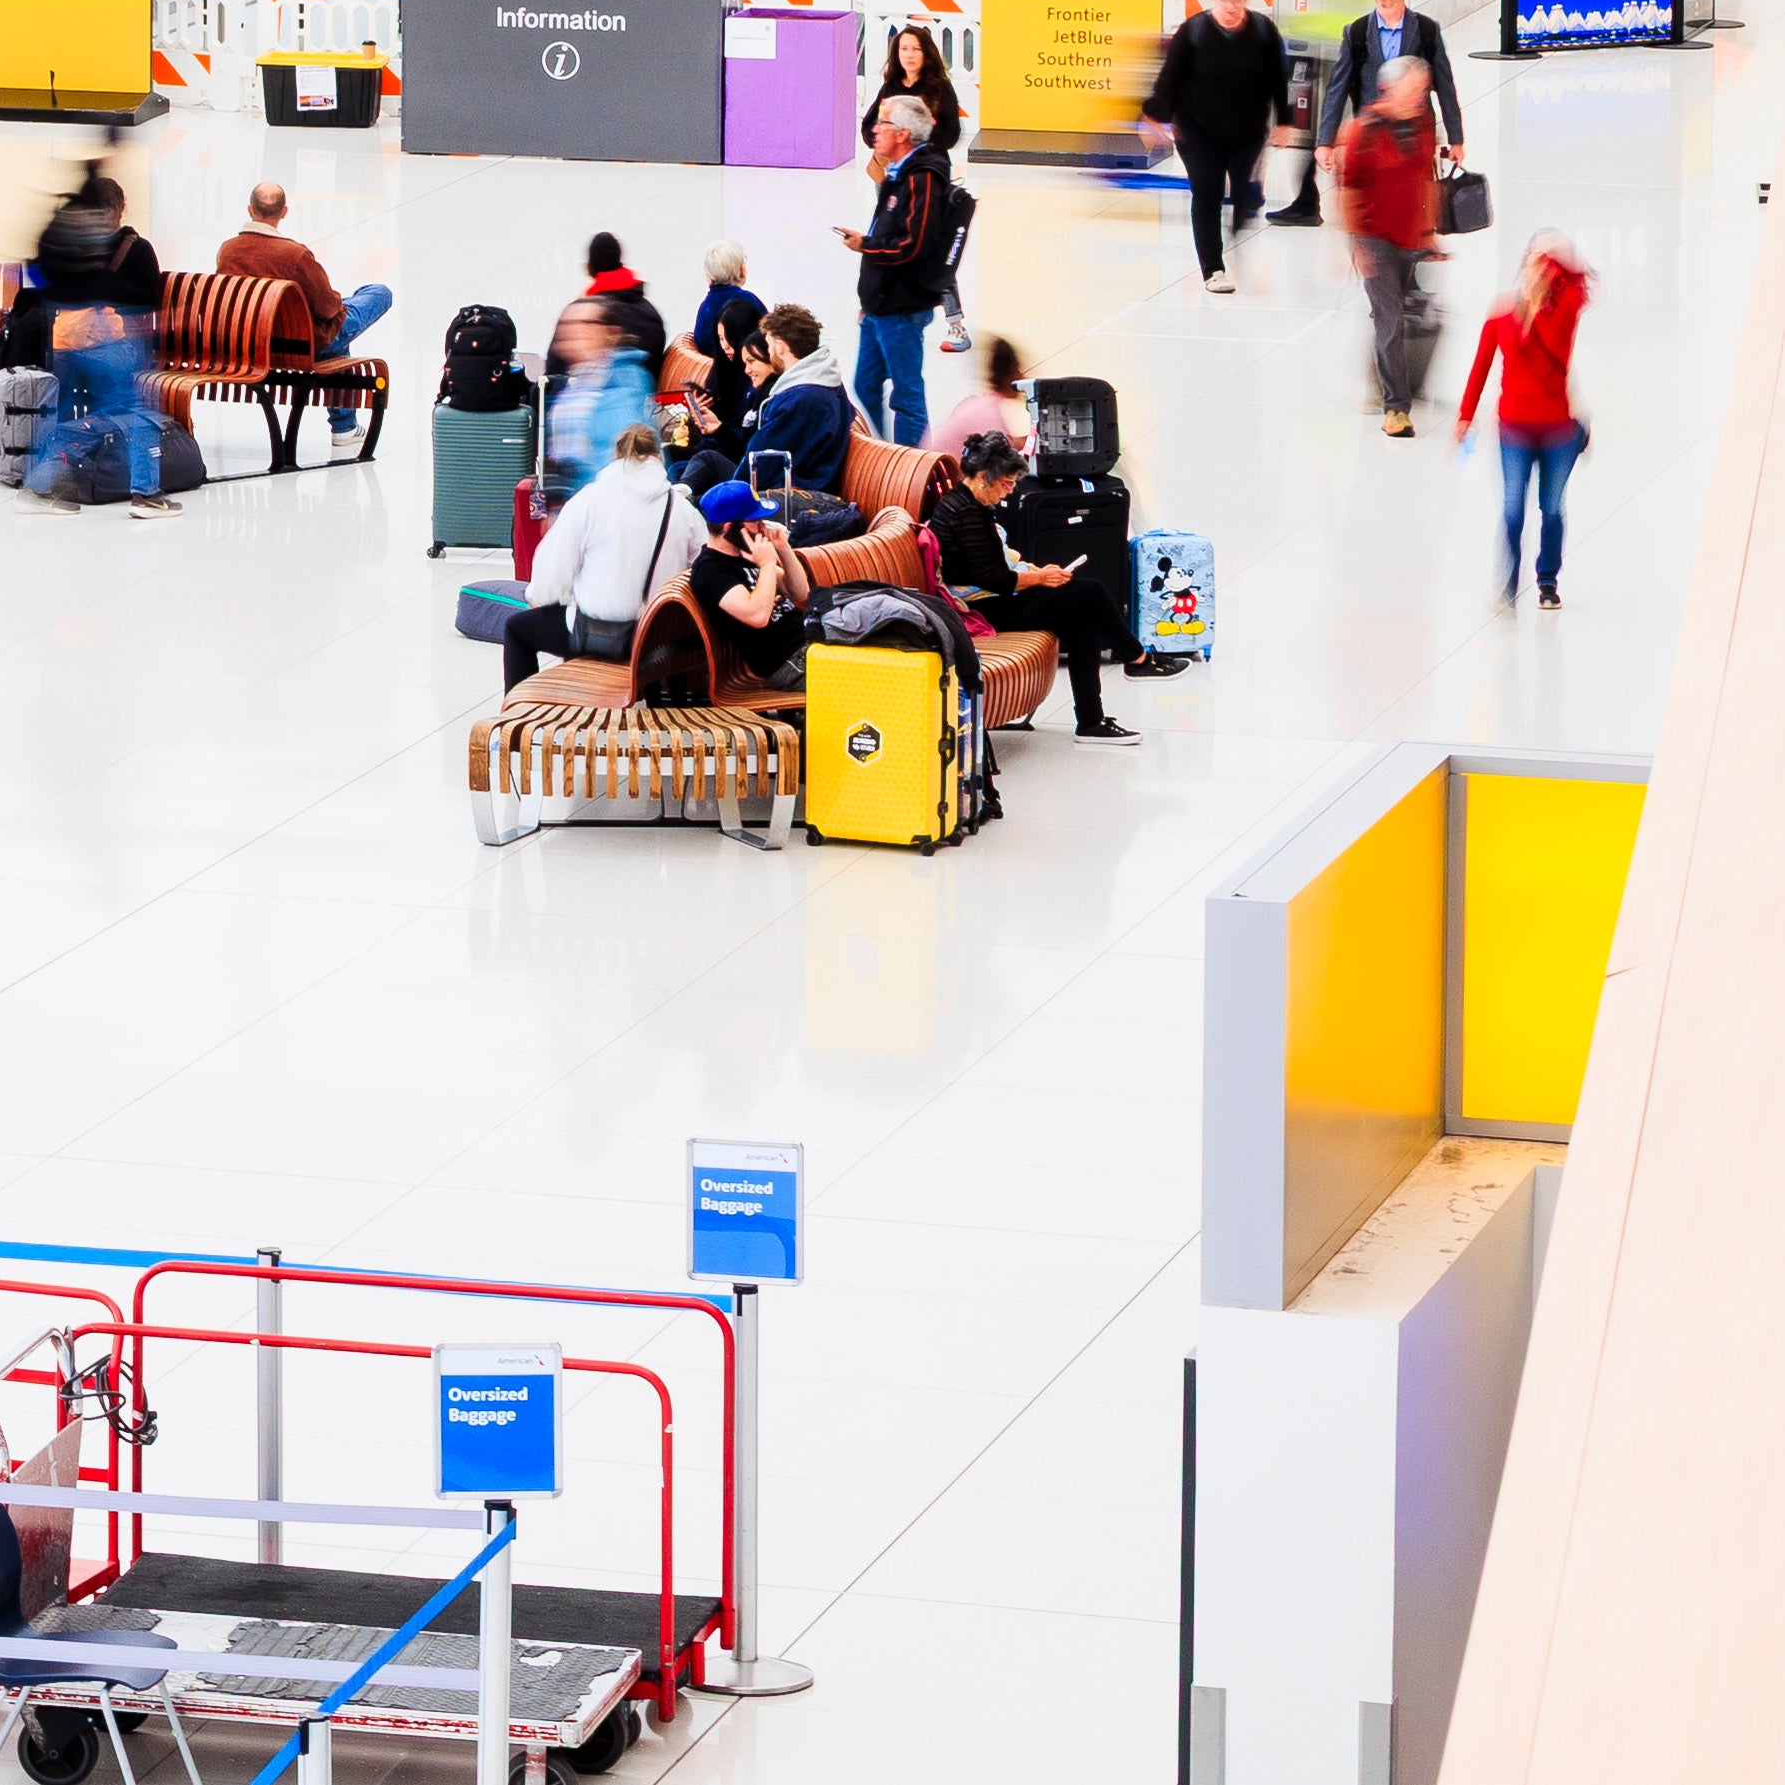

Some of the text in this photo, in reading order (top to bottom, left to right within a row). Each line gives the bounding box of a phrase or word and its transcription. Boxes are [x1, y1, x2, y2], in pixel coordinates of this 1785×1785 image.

[496, 7, 626, 32] Information
[1047, 8, 1111, 22] Frontier
[1054, 31, 1113, 45] JetBlue
[1037, 52, 1112, 67] Southern
[1024, 74, 1112, 90] Southwest
[745, 1153, 778, 1162] American
[701, 1178, 773, 1196] Oversized
[701, 1197, 763, 1215] Baggage
[497, 1356, 533, 1366] American
[449, 1387, 528, 1402] Oversized
[449, 1408, 516, 1425] Baggage
